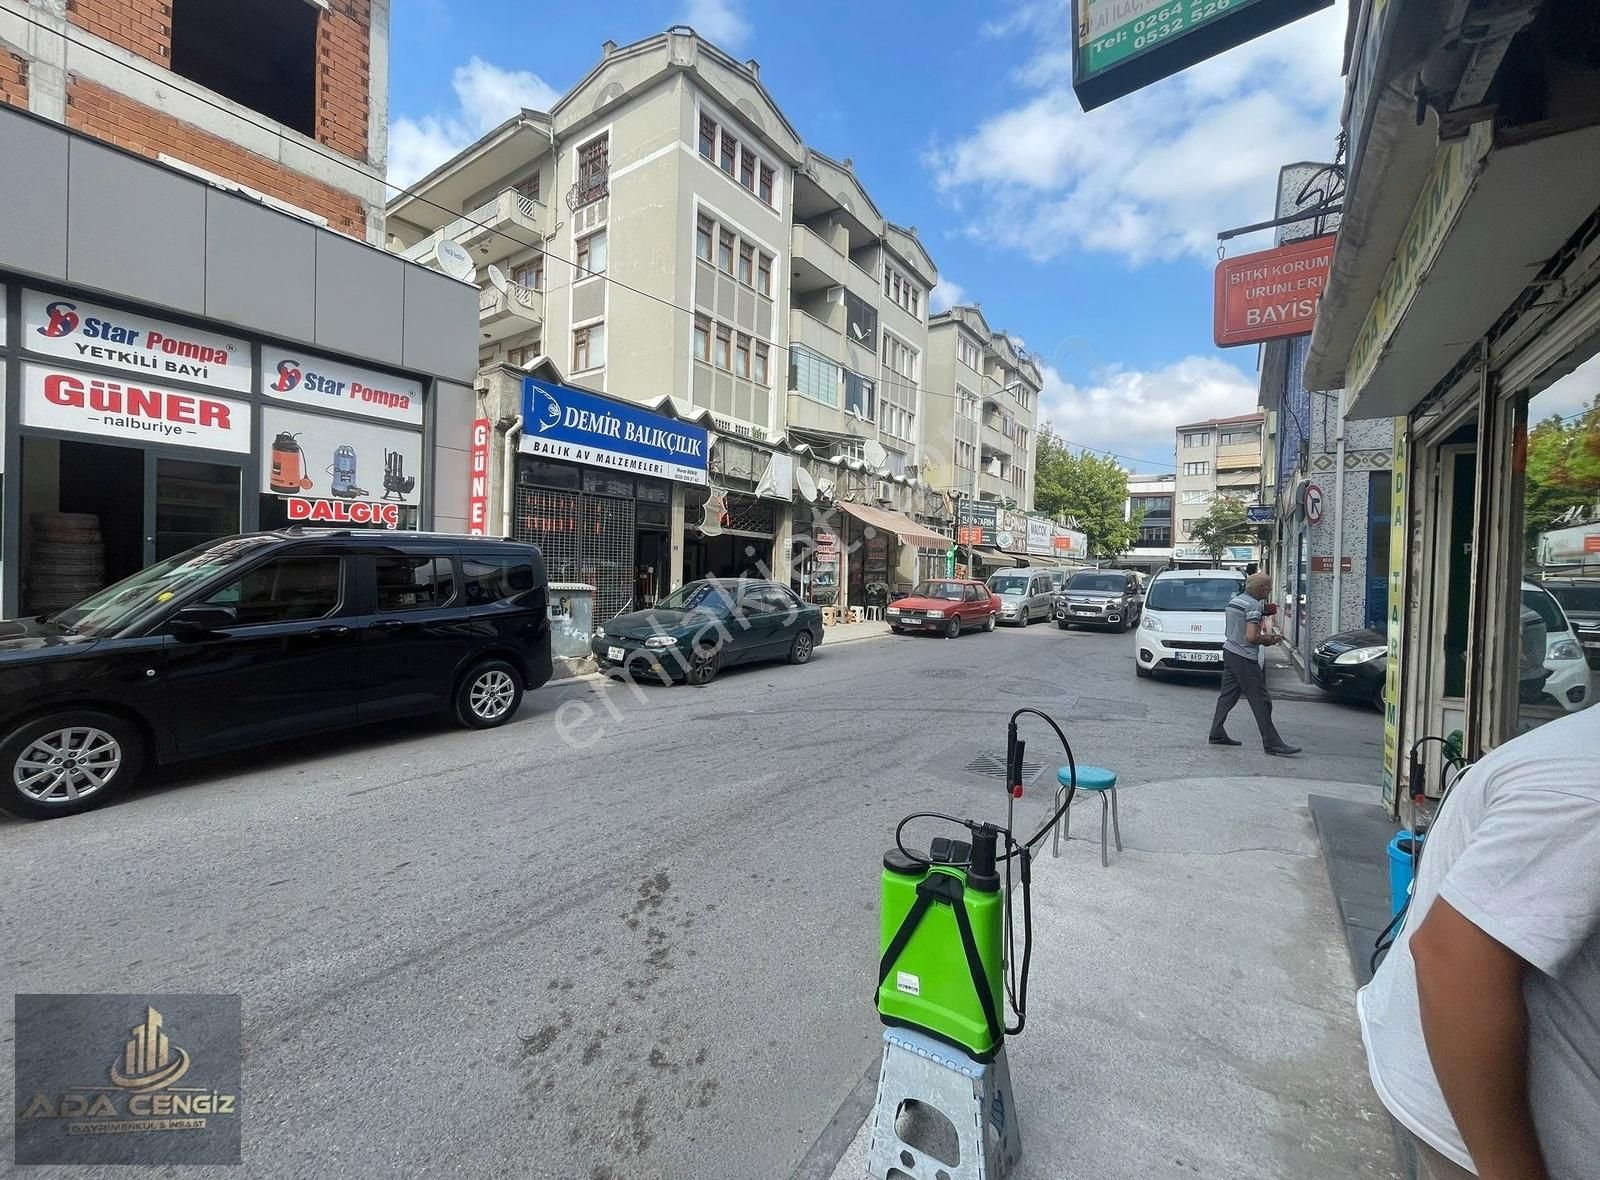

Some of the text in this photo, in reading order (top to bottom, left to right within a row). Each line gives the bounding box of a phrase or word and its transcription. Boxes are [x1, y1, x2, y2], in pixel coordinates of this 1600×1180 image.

[1093, 2, 1183, 53] Tel: 0264
[1133, 18, 1183, 48] 0532
[1231, 255, 1329, 284] BİTKİ KORUM
[83, 317, 140, 346] Star
[75, 343, 208, 378] YETKİLİ BAYİ
[304, 372, 346, 396] Star
[104, 415, 182, 436] nalburiye
[563, 406, 702, 457] DEMİR BALIKÇILIK
[533, 441, 570, 457] BALIK
[576, 451, 590, 461] AV
[288, 497, 399, 529] DALGIÇ
